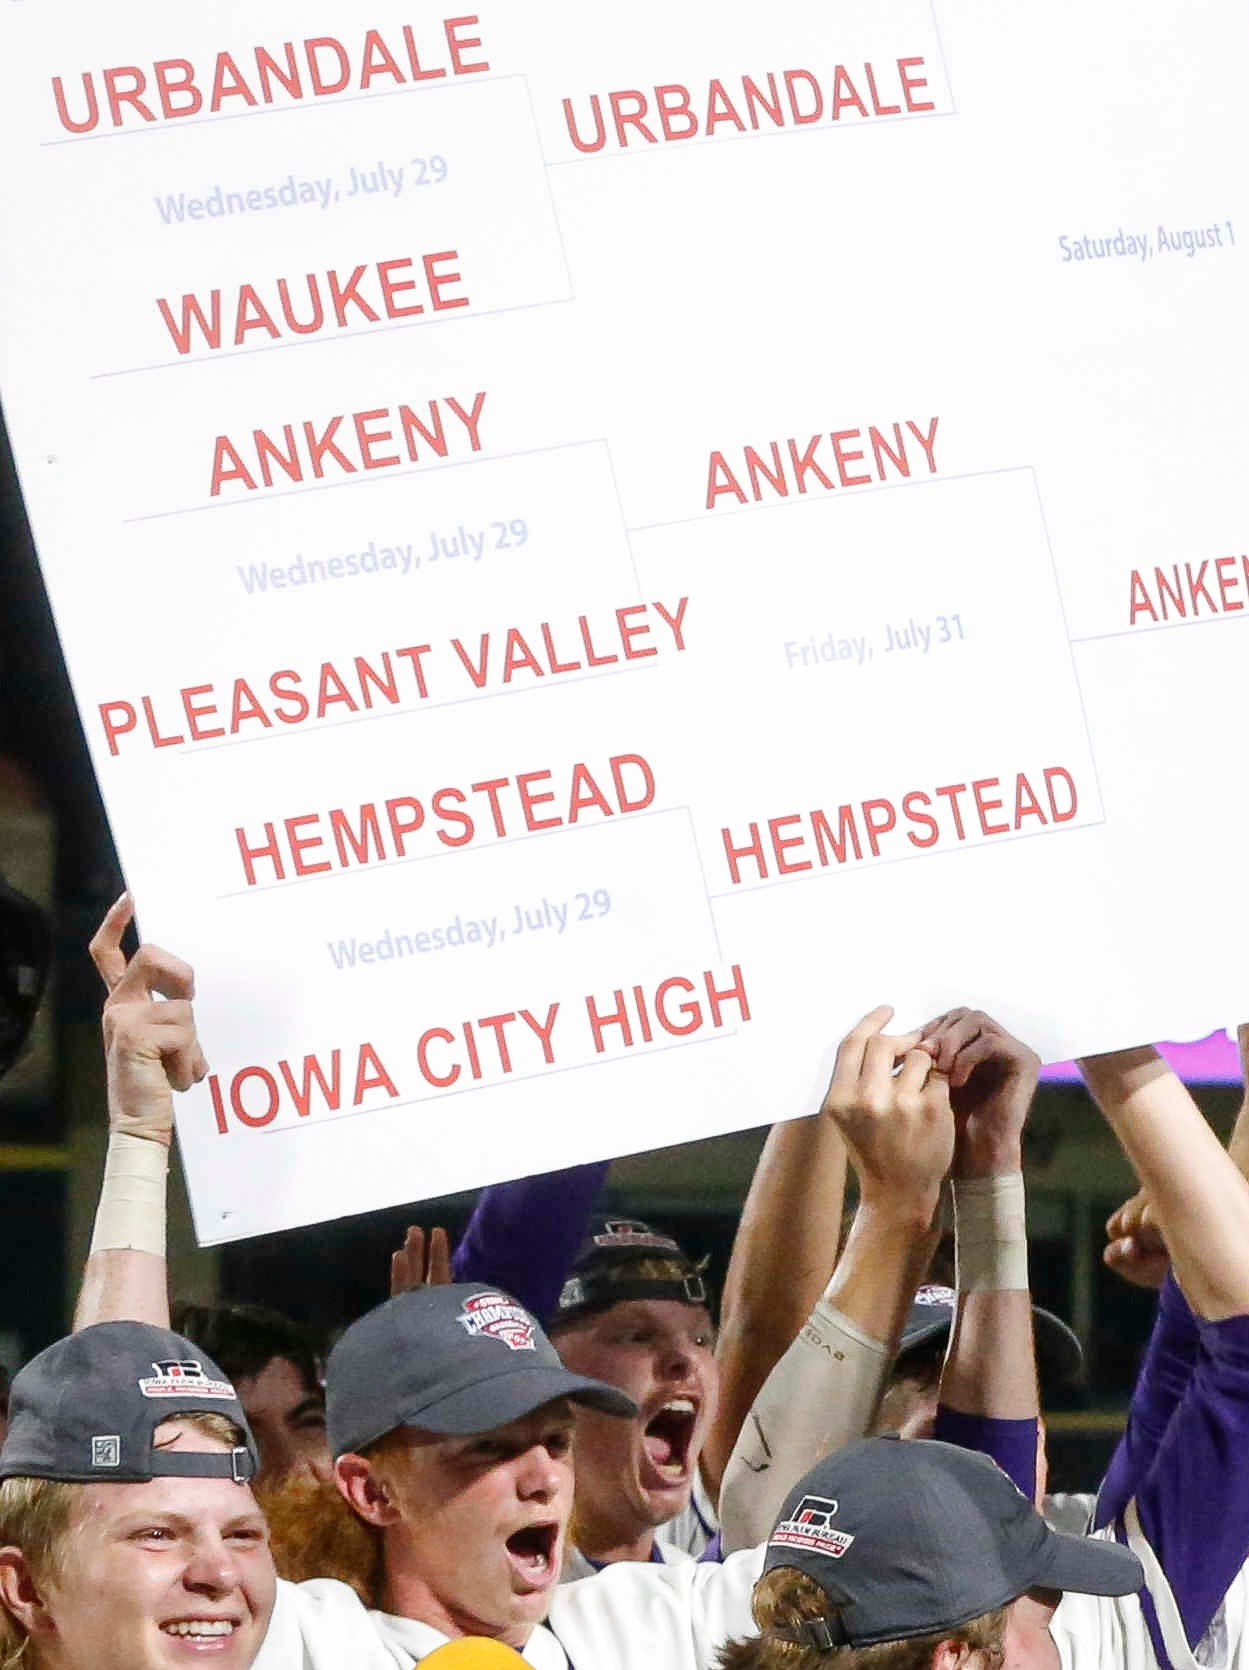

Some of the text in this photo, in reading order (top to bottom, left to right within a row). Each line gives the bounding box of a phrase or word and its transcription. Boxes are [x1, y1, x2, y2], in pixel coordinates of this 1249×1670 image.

[52, 15, 489, 133] URBANDALE
[564, 57, 935, 153] URBANDALE
[154, 154, 449, 225] Wednesday, July 29
[1058, 220, 1236, 263] Saturday, August 1
[156, 250, 470, 355] WAUKEE
[210, 392, 487, 497] ANKENY
[705, 416, 940, 510] ANKENY
[238, 518, 529, 594] Wednesday, July 29
[98, 597, 690, 757] PLEASANT VALLEY
[783, 613, 967, 669] Friday, July 31
[234, 752, 656, 887] HEMPSTEAD
[720, 765, 1080, 886] HEMPSTEAD
[328, 888, 613, 970] Wednesday, July 29
[207, 964, 752, 1136] IOWA CITY HIGH
